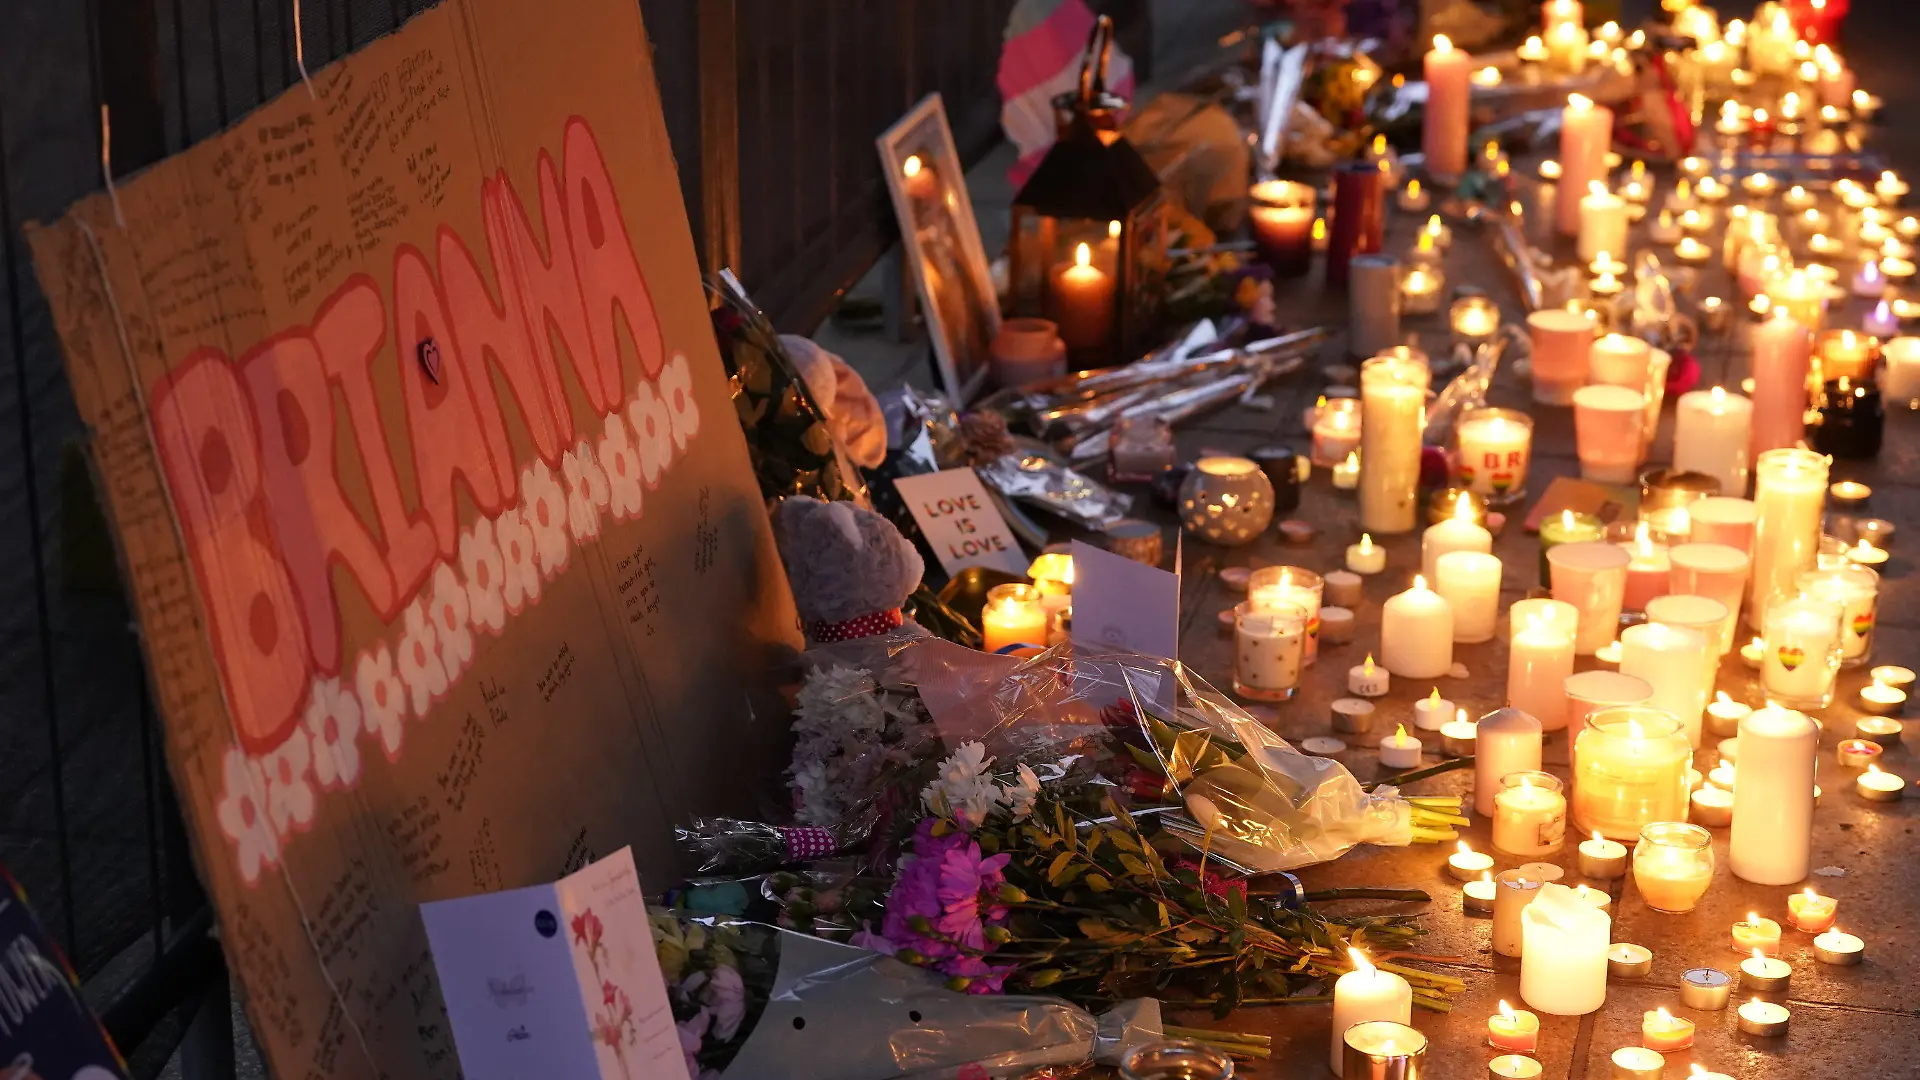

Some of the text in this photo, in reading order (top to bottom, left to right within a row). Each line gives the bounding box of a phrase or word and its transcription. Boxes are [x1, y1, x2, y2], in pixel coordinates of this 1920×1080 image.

[152, 115, 665, 757] BRIANNA
[923, 494, 981, 519] LOVE
[955, 517, 976, 535] IS
[948, 534, 1007, 560] LOVE
